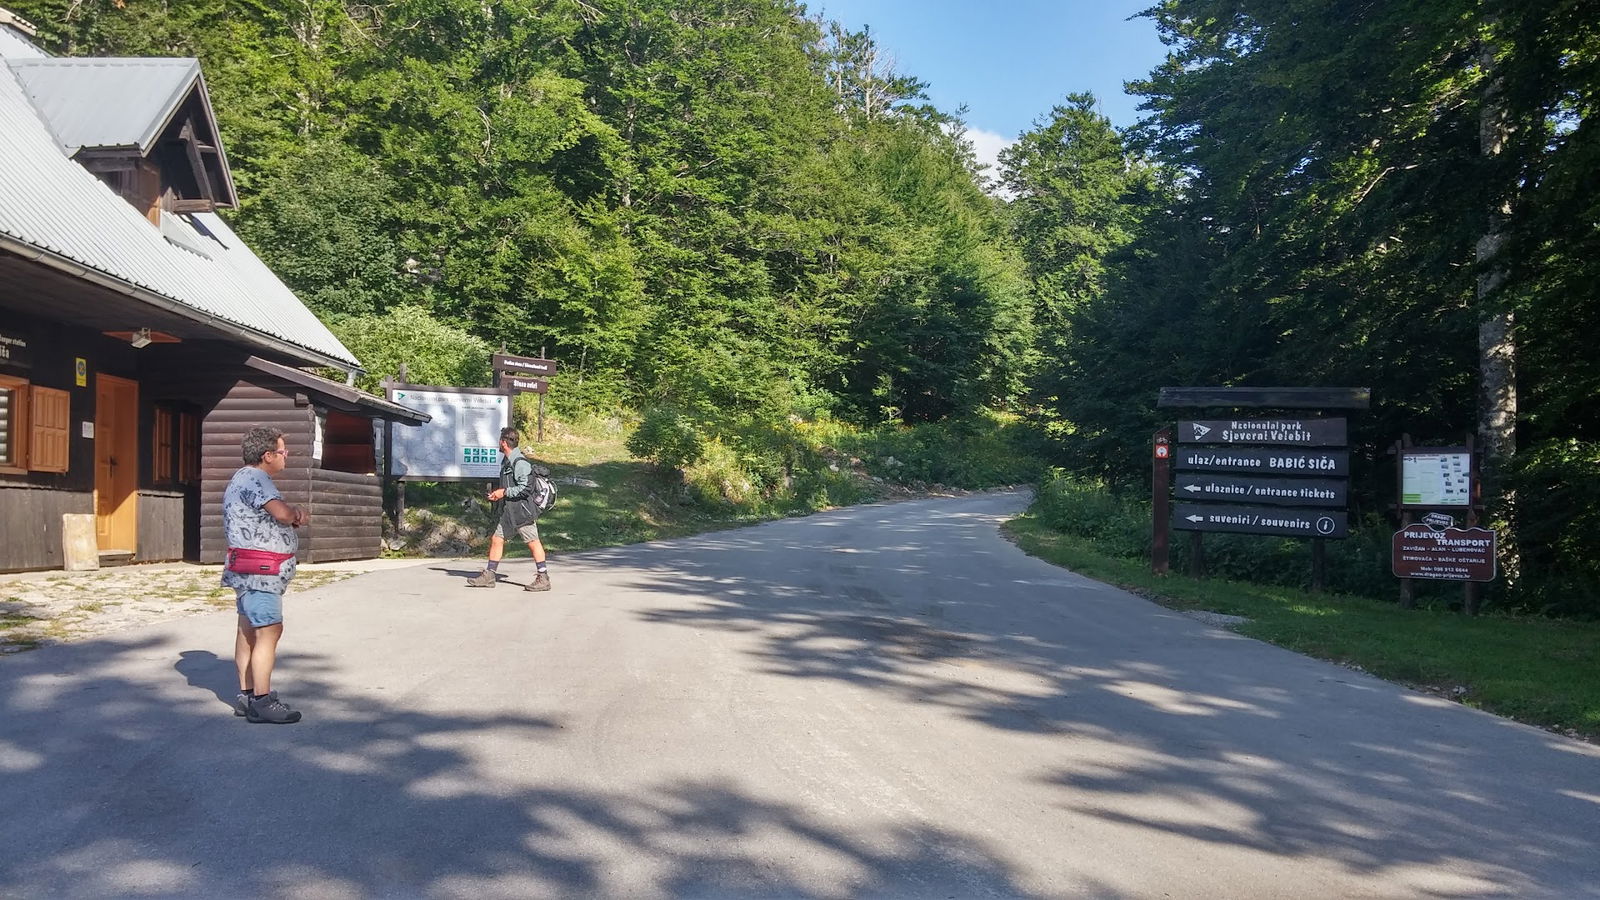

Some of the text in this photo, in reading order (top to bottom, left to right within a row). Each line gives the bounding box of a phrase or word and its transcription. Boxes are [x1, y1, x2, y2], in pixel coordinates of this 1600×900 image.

[1281, 421, 1302, 432] park
[1222, 430, 1312, 442] Sjeverni Velebit
[1188, 455, 1336, 470] ulaz/entrance BABIĆ SIČA
[1205, 483, 1245, 494] ulaznice
[1255, 486, 1298, 497] entrance
[1300, 487, 1335, 499] tickets
[1209, 514, 1250, 525] suveniri
[1261, 517, 1311, 529] souvenirs
[1404, 531, 1446, 539] PRIJEVOZ
[1436, 539, 1491, 547] TRANSPORT
